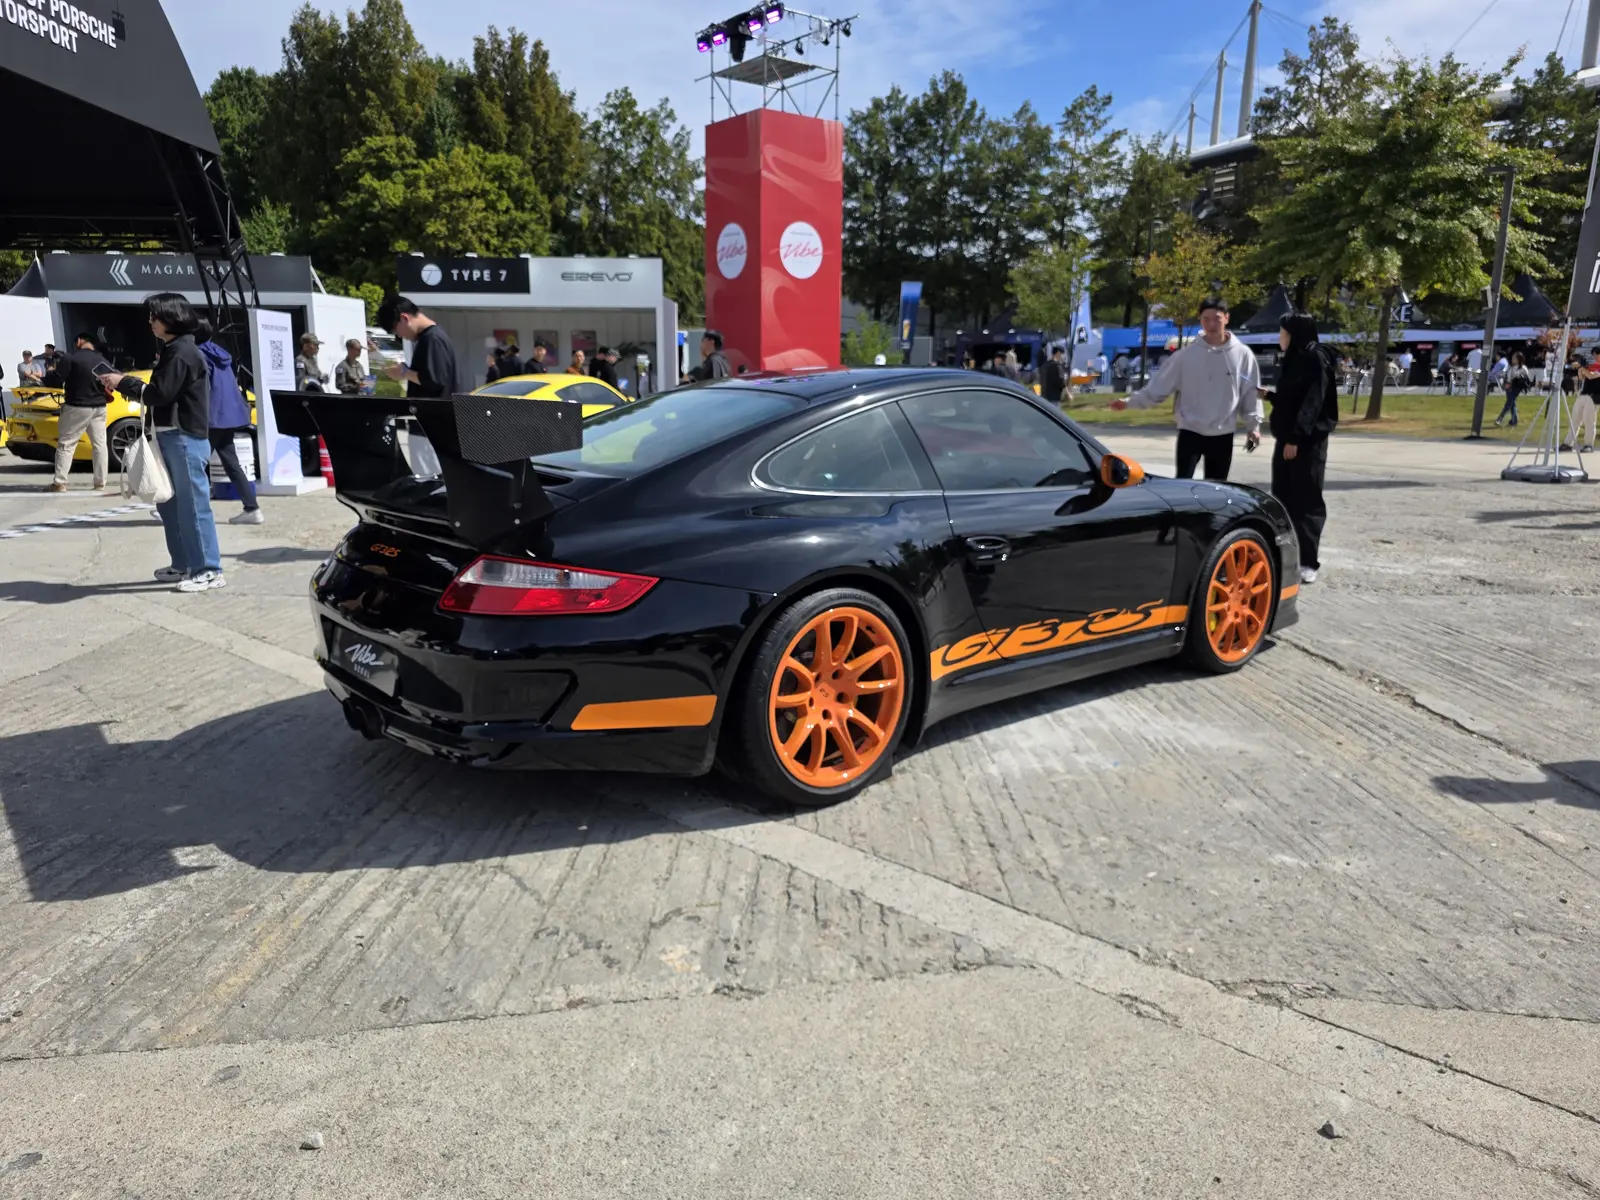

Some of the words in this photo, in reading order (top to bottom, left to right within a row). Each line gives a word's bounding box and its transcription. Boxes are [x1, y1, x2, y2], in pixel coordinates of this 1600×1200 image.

[50, 0, 117, 49] PORSCHE
[450, 268, 492, 282] TYPE
[498, 268, 508, 282] 7
[344, 643, 385, 666] Vibe
